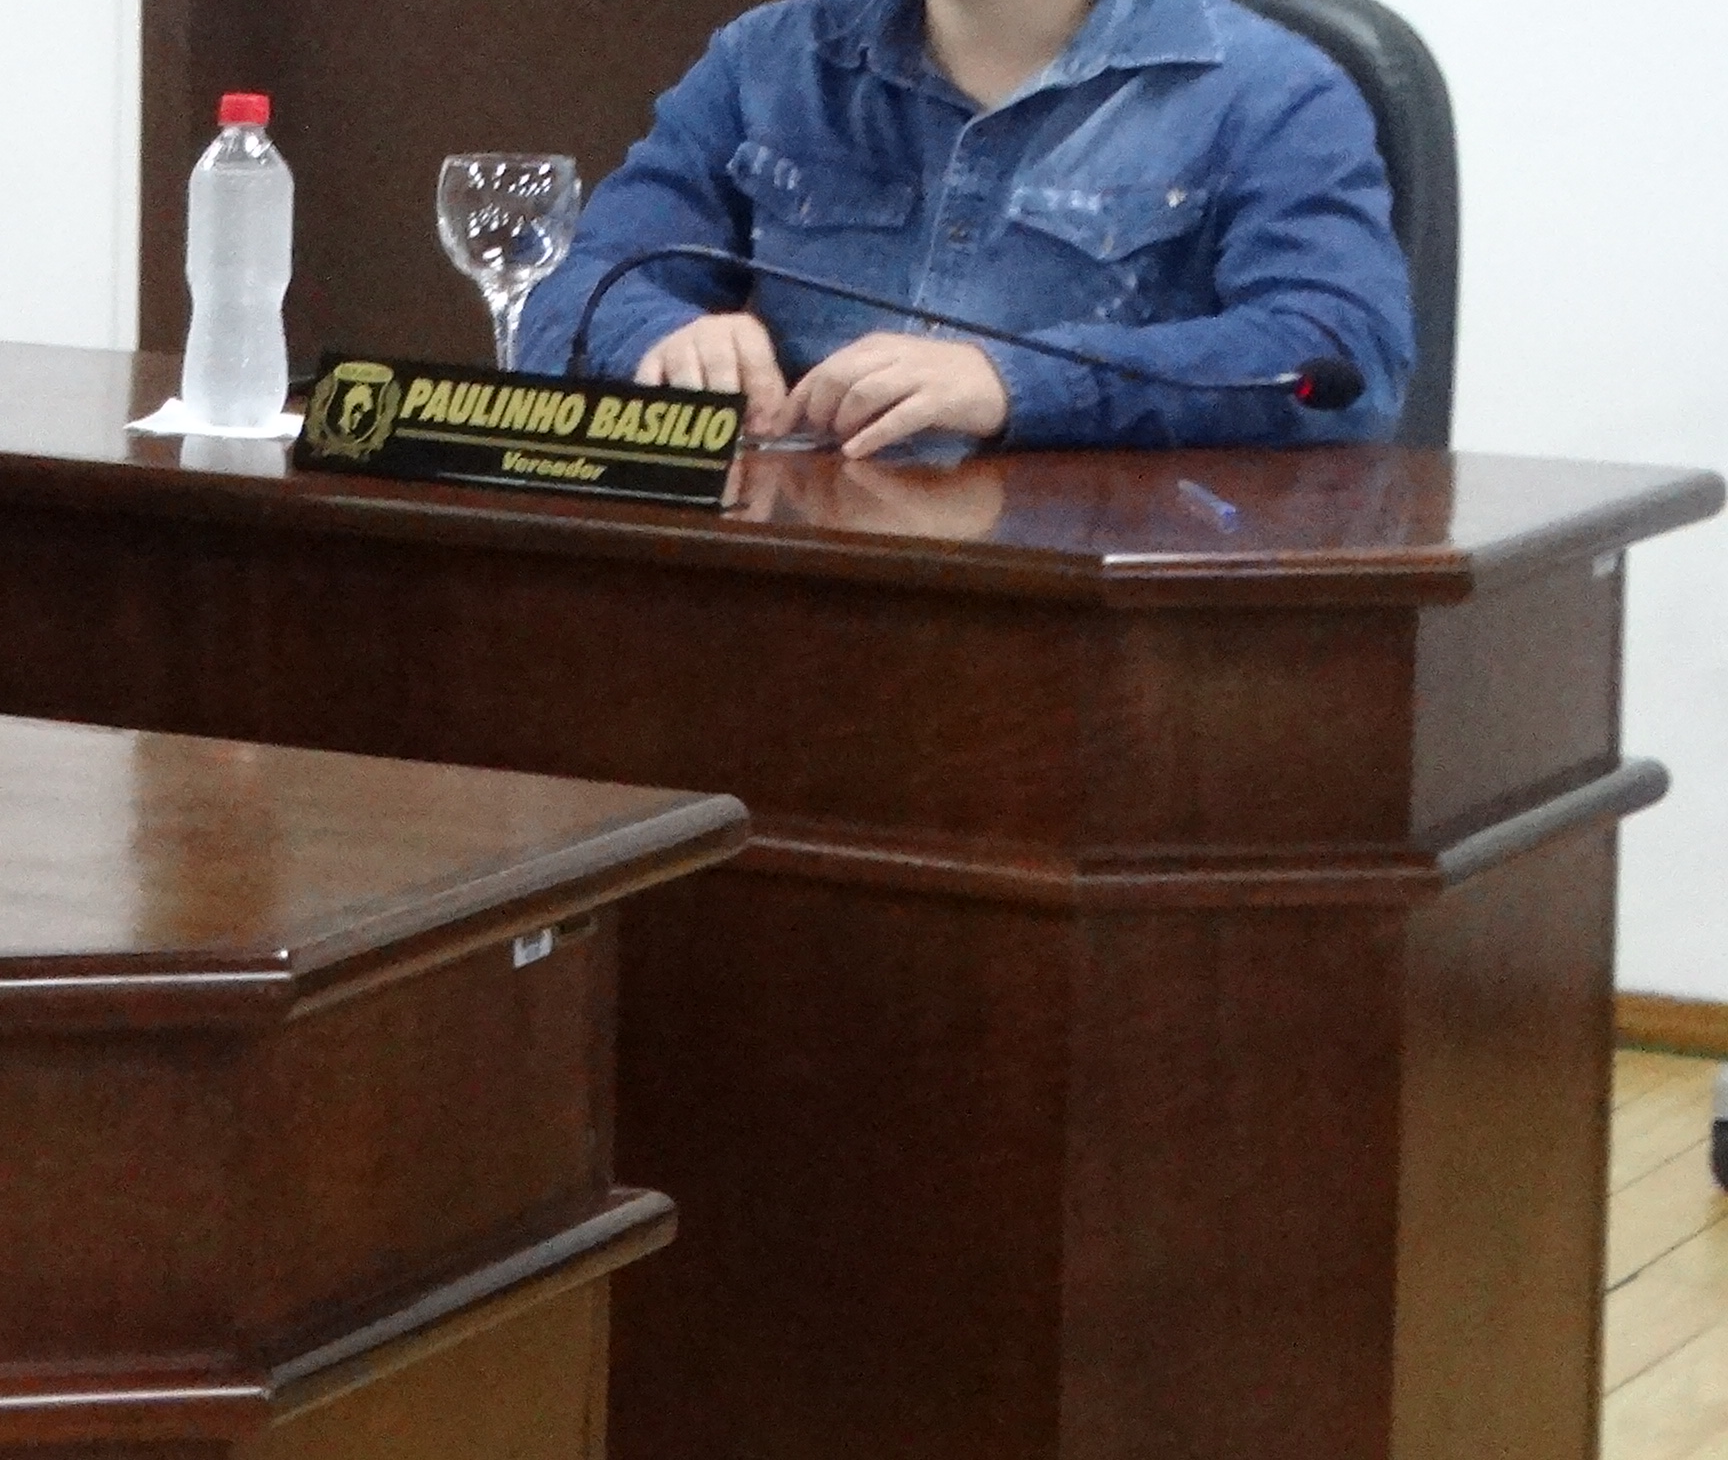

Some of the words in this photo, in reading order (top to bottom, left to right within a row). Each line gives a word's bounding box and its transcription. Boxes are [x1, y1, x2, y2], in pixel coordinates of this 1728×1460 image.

[400, 377, 587, 436] PAULINHO
[586, 395, 739, 452] BASILIO
[501, 451, 607, 481] Vereador
